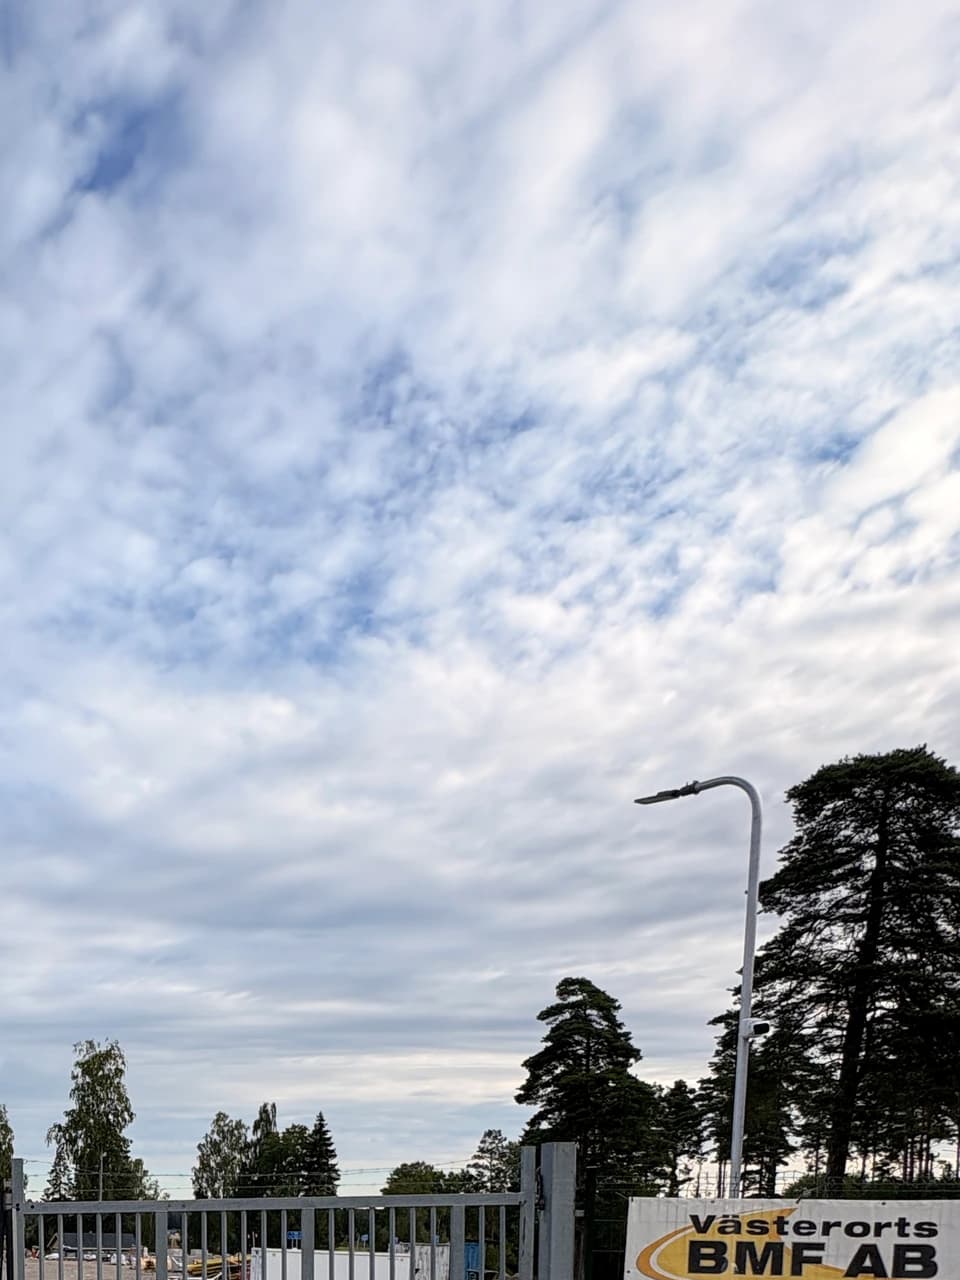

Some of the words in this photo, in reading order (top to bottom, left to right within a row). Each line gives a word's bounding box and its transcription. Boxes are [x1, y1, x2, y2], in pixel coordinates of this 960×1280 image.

[689, 1214, 939, 1238] Västerorts
[687, 1240, 826, 1276] BMF
[843, 1243, 939, 1279] AB
